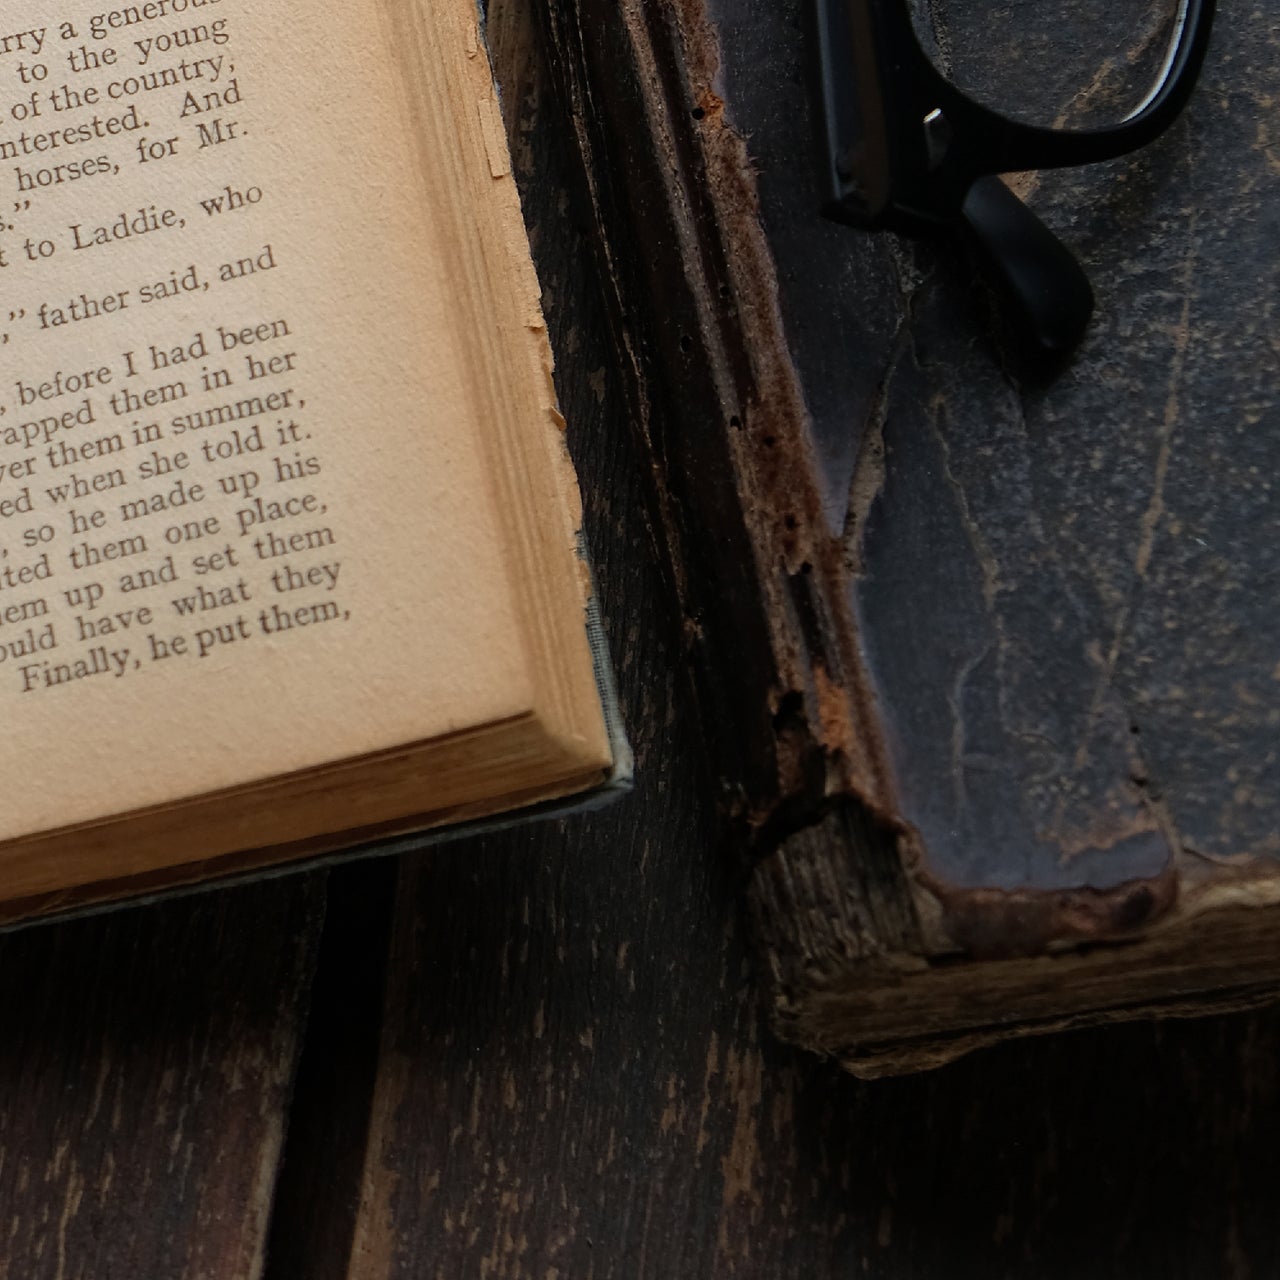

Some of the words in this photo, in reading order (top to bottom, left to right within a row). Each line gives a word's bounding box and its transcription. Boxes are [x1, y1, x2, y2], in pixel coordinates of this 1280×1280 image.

[57, 20, 80, 42] a
[178, 77, 244, 120] And
[14, 365, 113, 407] before
[121, 350, 139, 379] I
[147, 331, 210, 372] had
[215, 318, 293, 353] been
[44, 468, 128, 505] when
[137, 450, 190, 481] she
[200, 423, 267, 464] told
[275, 419, 313, 447] it.
[17, 645, 142, 694] Finally,
[146, 633, 189, 663] he
[193, 614, 252, 659] put
[257, 600, 351, 636] them,
